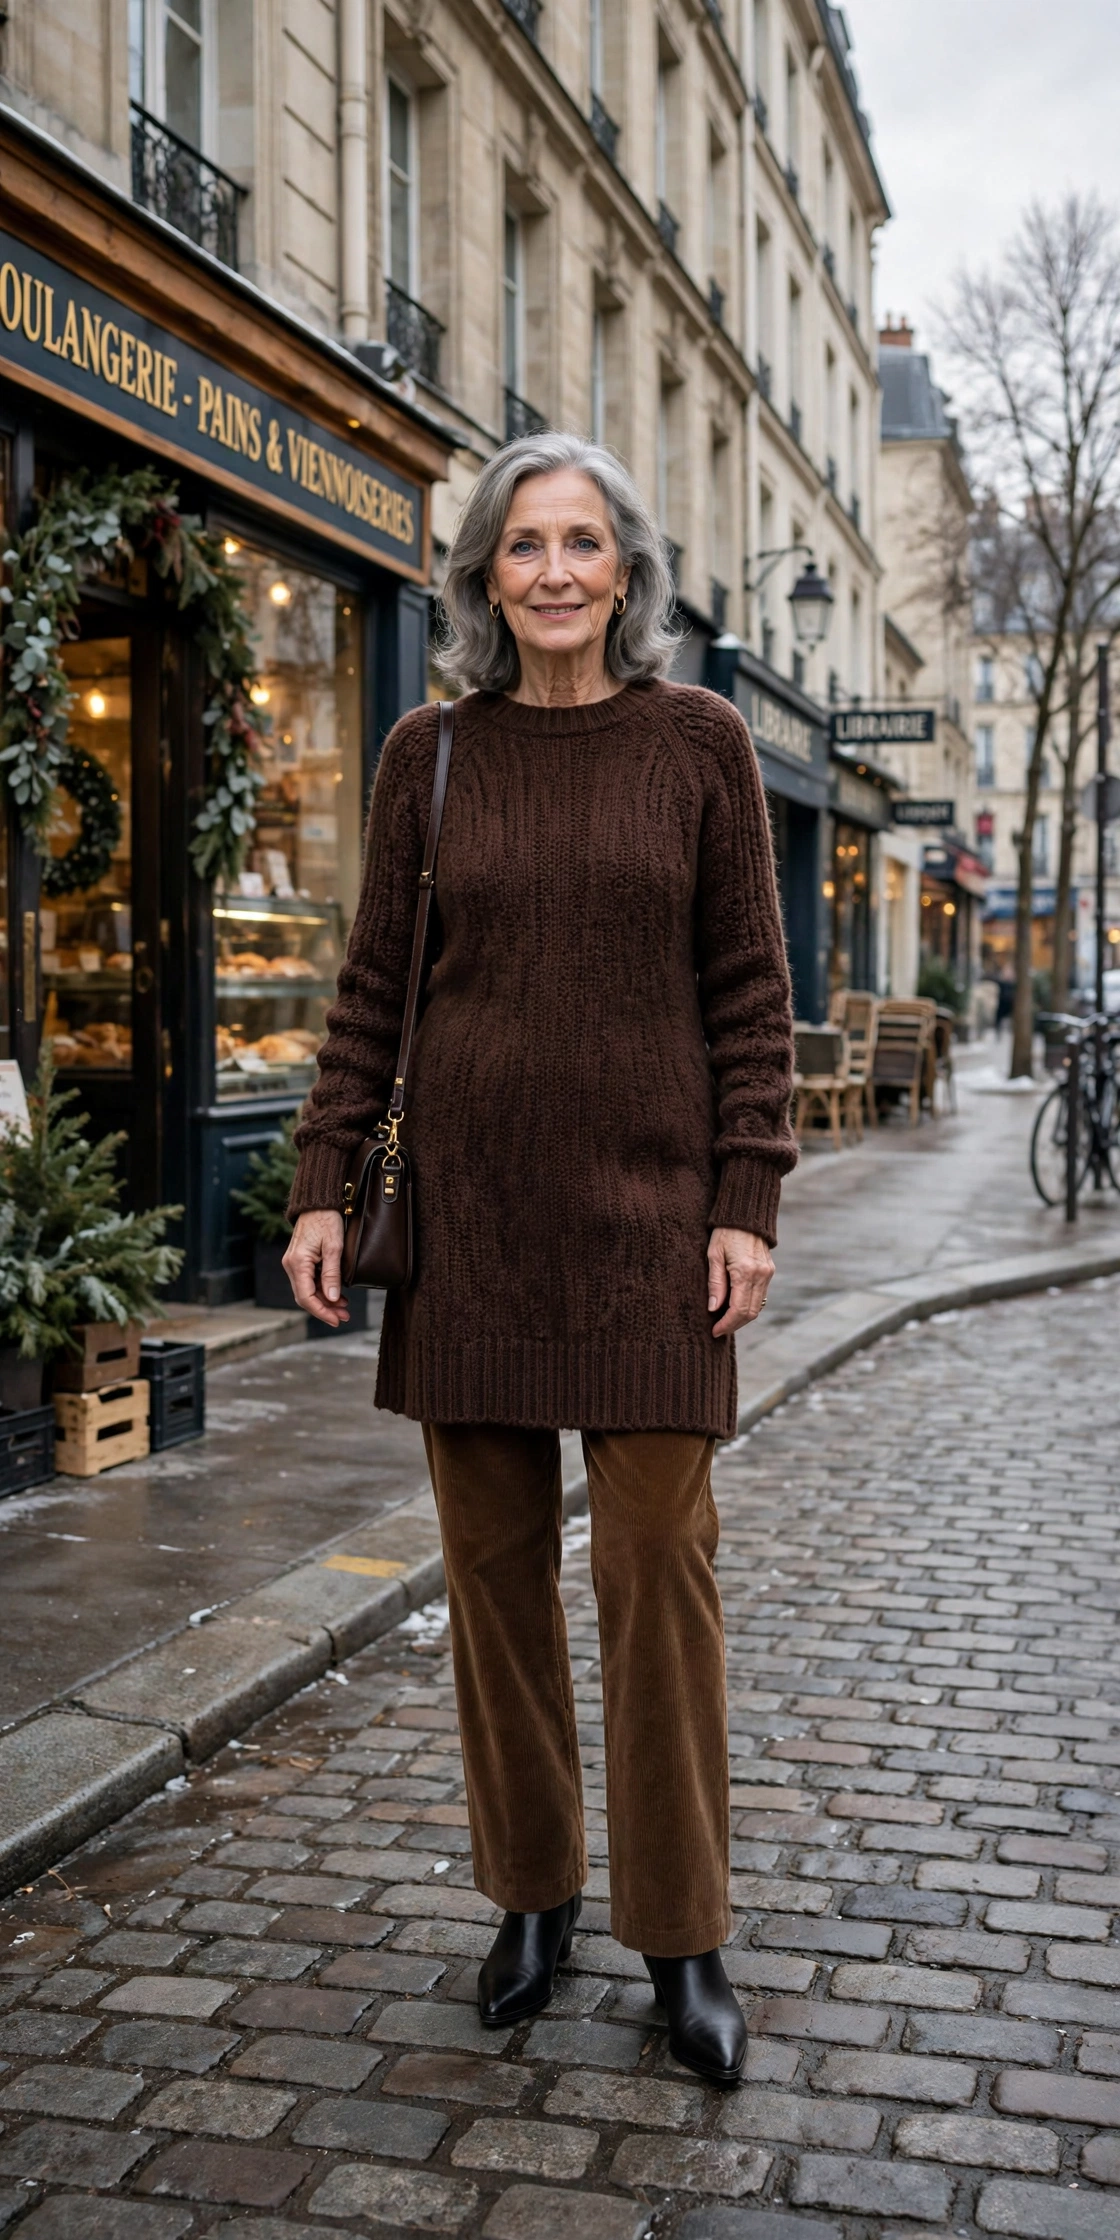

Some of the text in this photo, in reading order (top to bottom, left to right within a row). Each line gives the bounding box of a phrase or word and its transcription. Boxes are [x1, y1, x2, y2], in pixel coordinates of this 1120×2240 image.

[0, 262, 178, 418] OULANGERIE
[198, 375, 262, 462] PAINS
[266, 418, 283, 474] &
[287, 428, 414, 545] VIENNOISERIES
